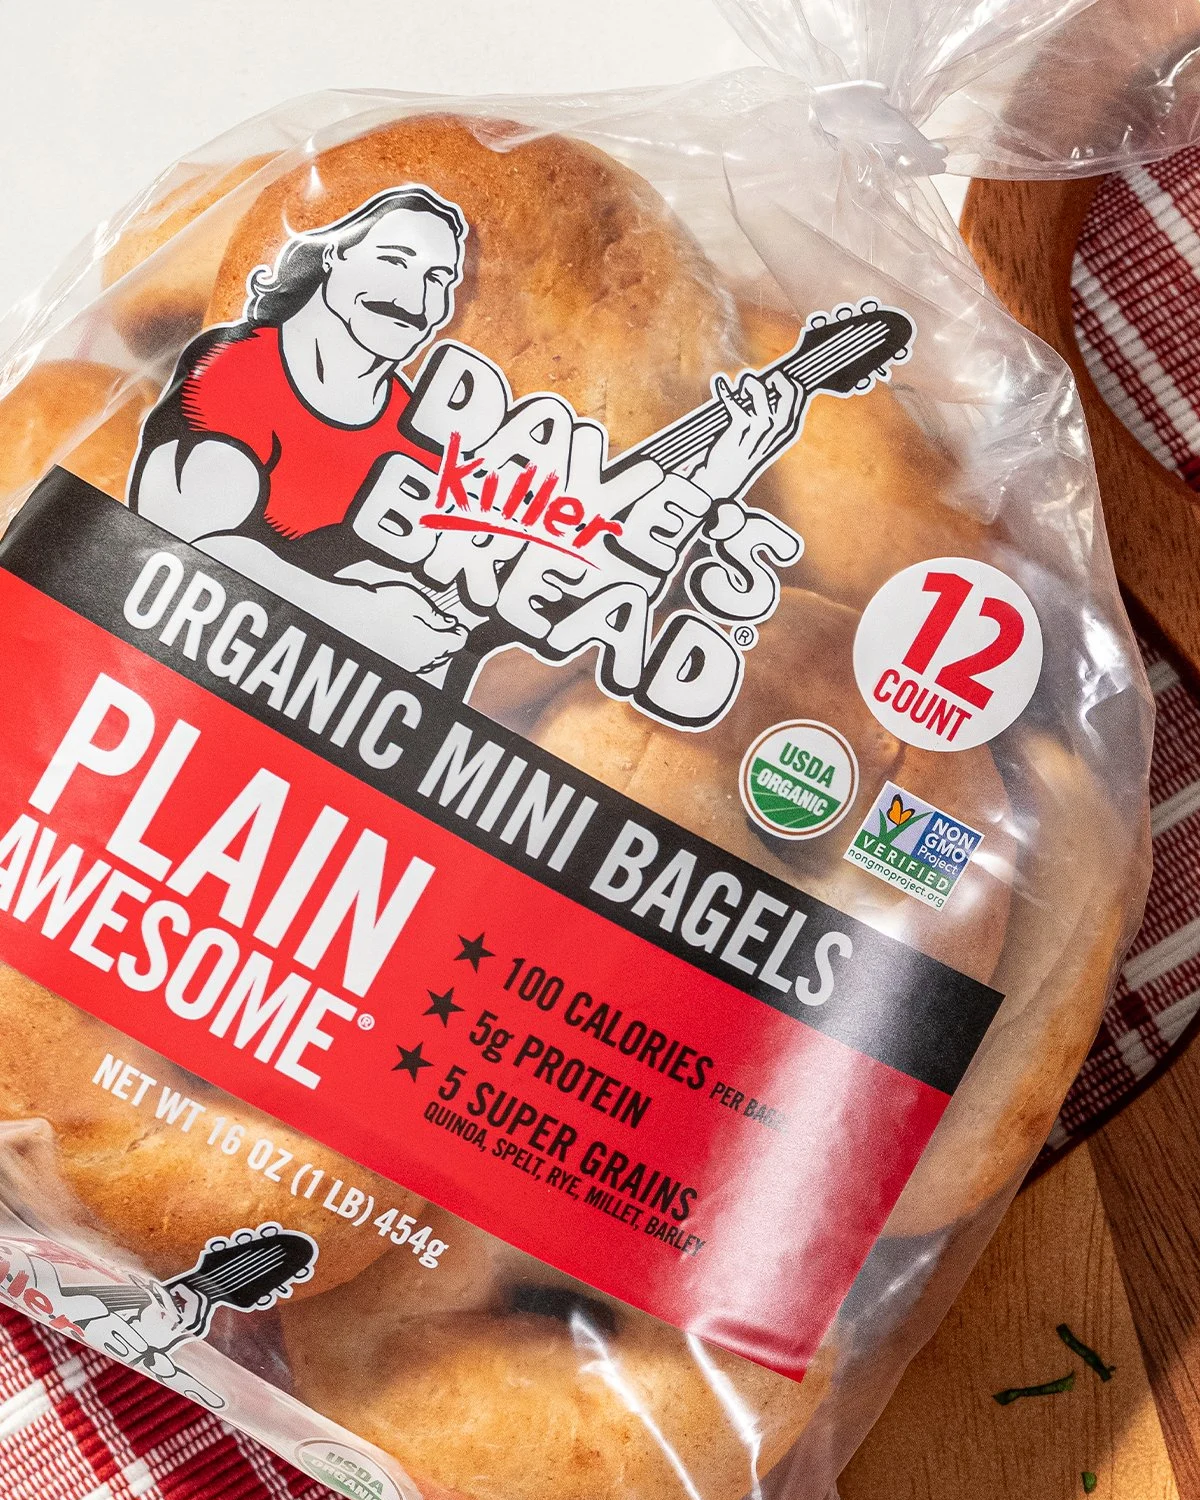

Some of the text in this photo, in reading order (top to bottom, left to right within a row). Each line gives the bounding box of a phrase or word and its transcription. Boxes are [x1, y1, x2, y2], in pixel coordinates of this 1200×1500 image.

[399, 344, 803, 620] DAVE'S
[901, 571, 1025, 711] 12
[872, 668, 973, 743] COUNT
[123, 551, 854, 1007] ORGANIC MINI BAGELS
[756, 767, 829, 818] ORGANIC
[778, 741, 836, 788] USDA
[28, 672, 437, 998] PLAIN
[848, 848, 944, 908] nongmoproject.org
[863, 835, 949, 891] VERIFIED
[917, 845, 958, 875] Project
[924, 833, 967, 864] GMO
[932, 818, 975, 850] NON
[469, 1010, 652, 1129] 5g PROTEIN
[502, 957, 564, 1012] 100
[563, 991, 714, 1091] CALORIES
[709, 1081, 745, 1112] PER
[92, 1053, 449, 1270] NET WT 16 OZ (1 LB) 454g
[424, 1101, 707, 1258] QUINOA, SPELT, RYE, MILLET, BARLEY
[438, 1065, 699, 1222] 5 SUPER GRAINS
[326, 1452, 384, 1495] USDA
